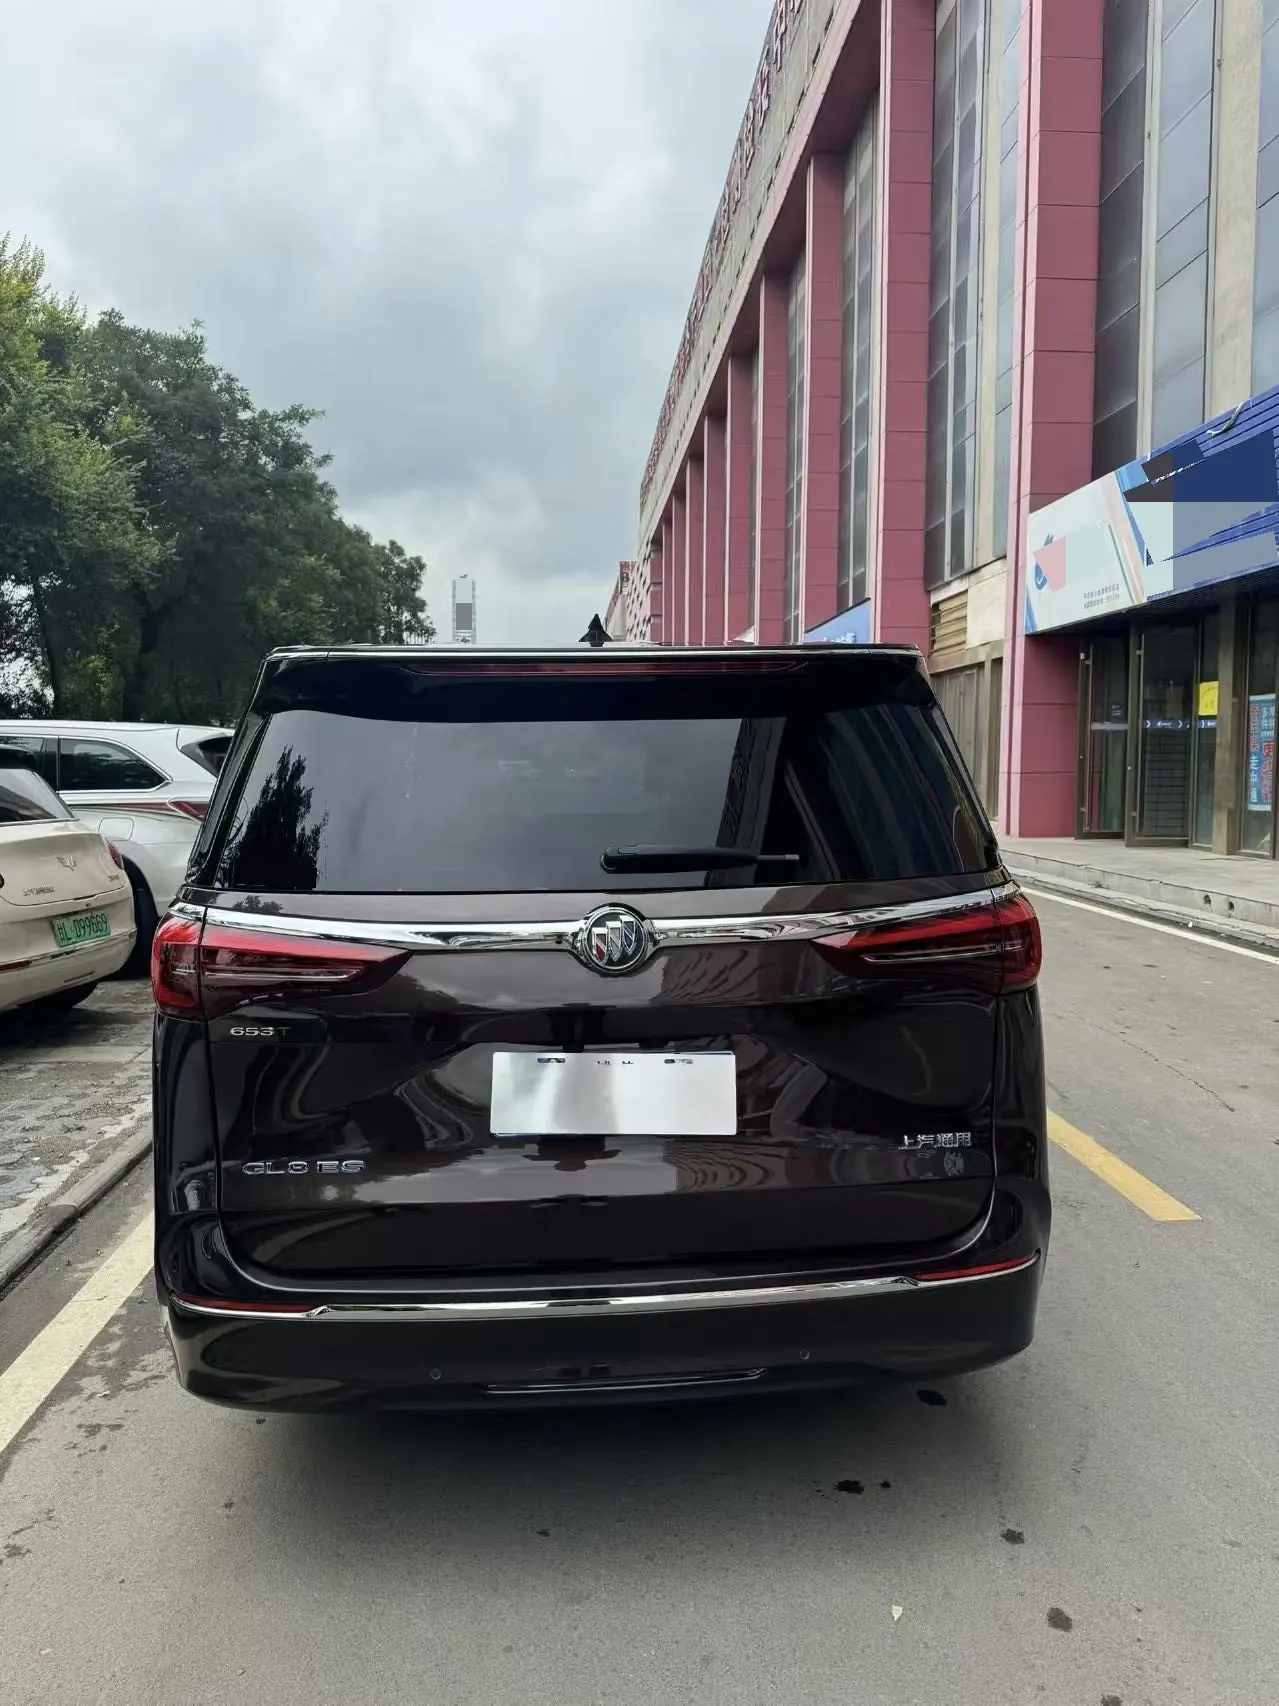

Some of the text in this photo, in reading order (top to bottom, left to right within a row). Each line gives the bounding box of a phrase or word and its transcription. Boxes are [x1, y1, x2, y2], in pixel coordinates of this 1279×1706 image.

[898, 1132, 972, 1150] 上汽通用
[242, 1160, 365, 1175] GL8 ES
